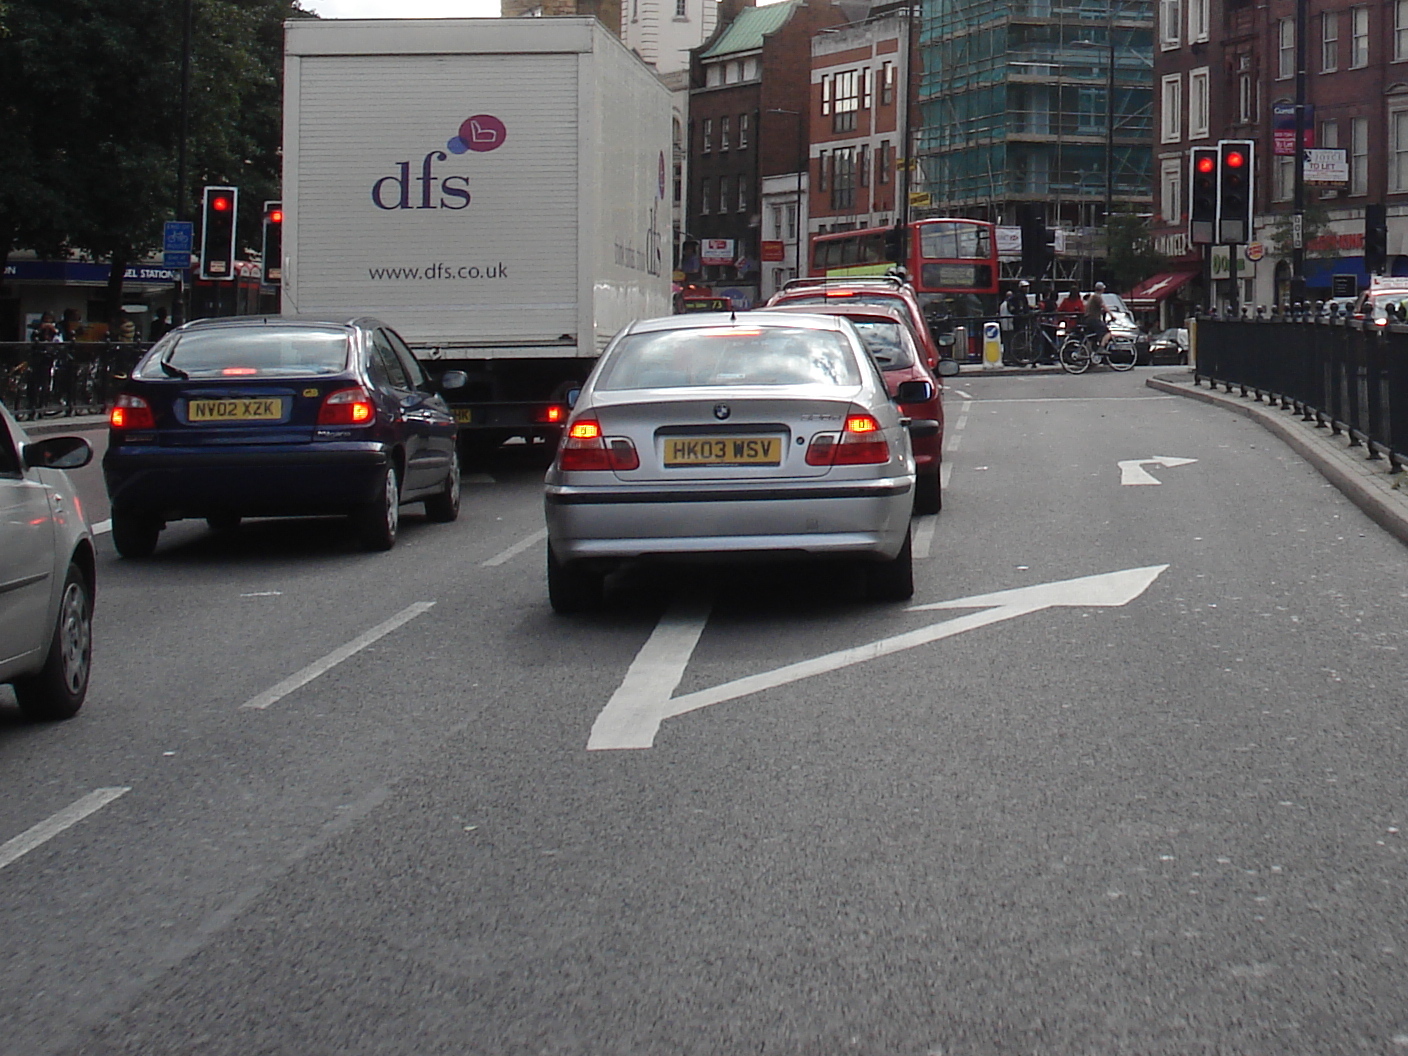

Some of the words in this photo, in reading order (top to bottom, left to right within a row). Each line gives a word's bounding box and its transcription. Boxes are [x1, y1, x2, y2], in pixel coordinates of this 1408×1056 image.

[372, 150, 471, 210] dfs
[368, 261, 509, 280] www.dfs.co.uk
[195, 402, 238, 417] NV02
[242, 401, 274, 416] XZK
[673, 441, 727, 460] HK03
[733, 440, 772, 459] WSV
